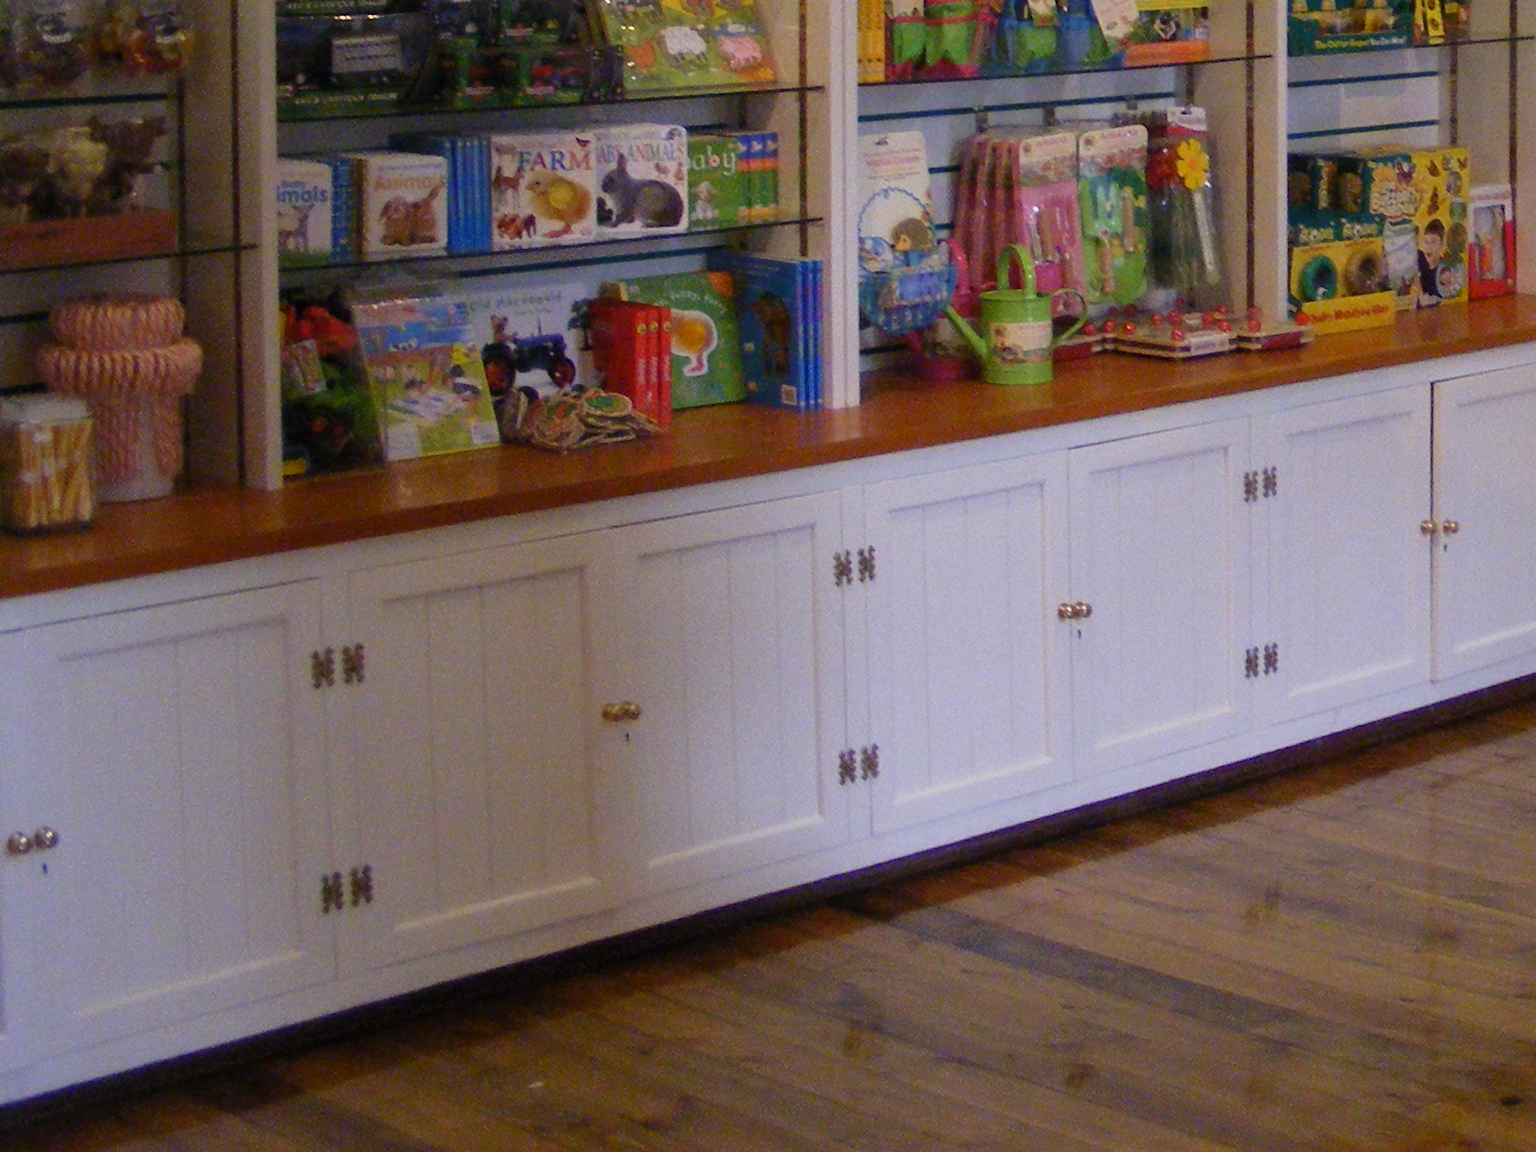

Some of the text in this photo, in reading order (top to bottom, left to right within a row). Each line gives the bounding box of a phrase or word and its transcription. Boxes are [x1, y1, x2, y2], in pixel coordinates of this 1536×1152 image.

[518, 150, 592, 173] FARM
[687, 145, 737, 176] aby
[277, 186, 328, 203] imals
